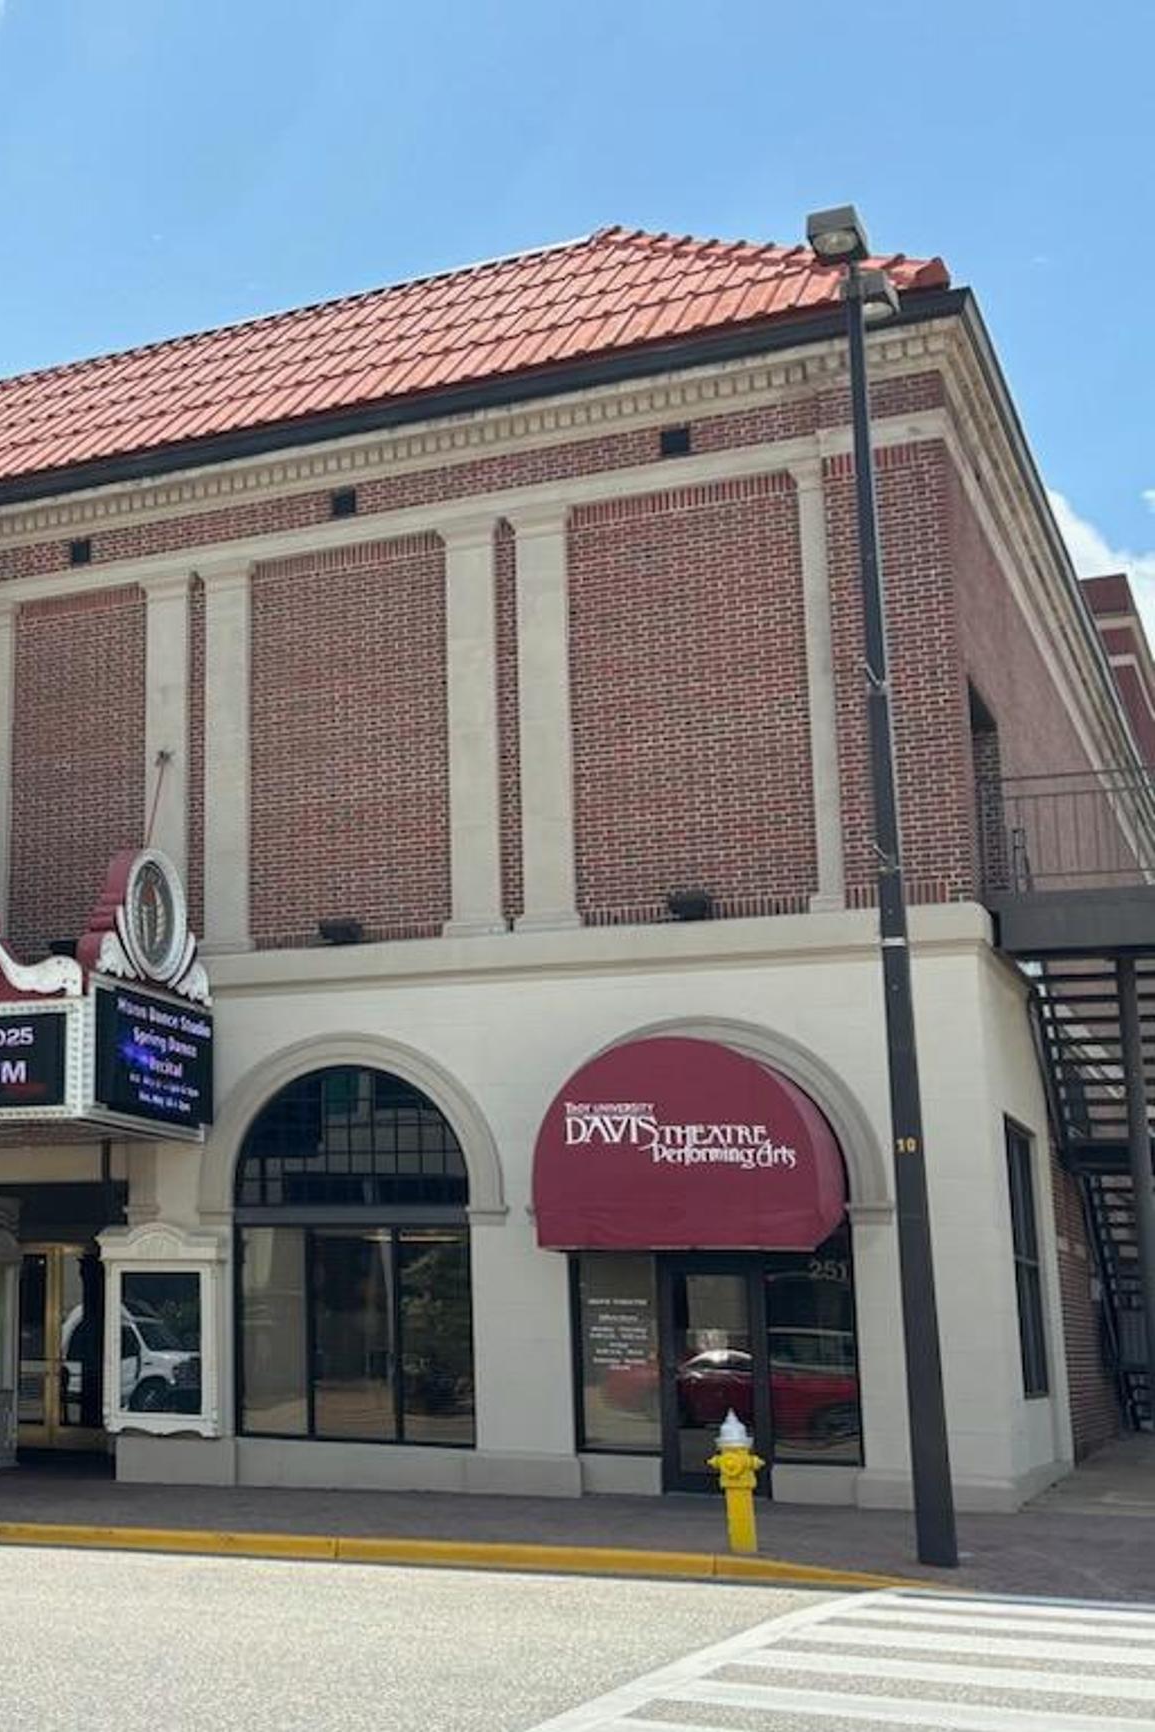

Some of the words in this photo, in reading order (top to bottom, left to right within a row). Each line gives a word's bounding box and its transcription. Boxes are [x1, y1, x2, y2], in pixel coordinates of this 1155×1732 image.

[565, 1114, 660, 1151] DAVIS
[658, 1124, 768, 1149] THEATRE
[896, 1136, 917, 1153] 10
[652, 1144, 754, 1169] Performing
[755, 1138, 796, 1169] Arts
[808, 1259, 847, 1282] 251
